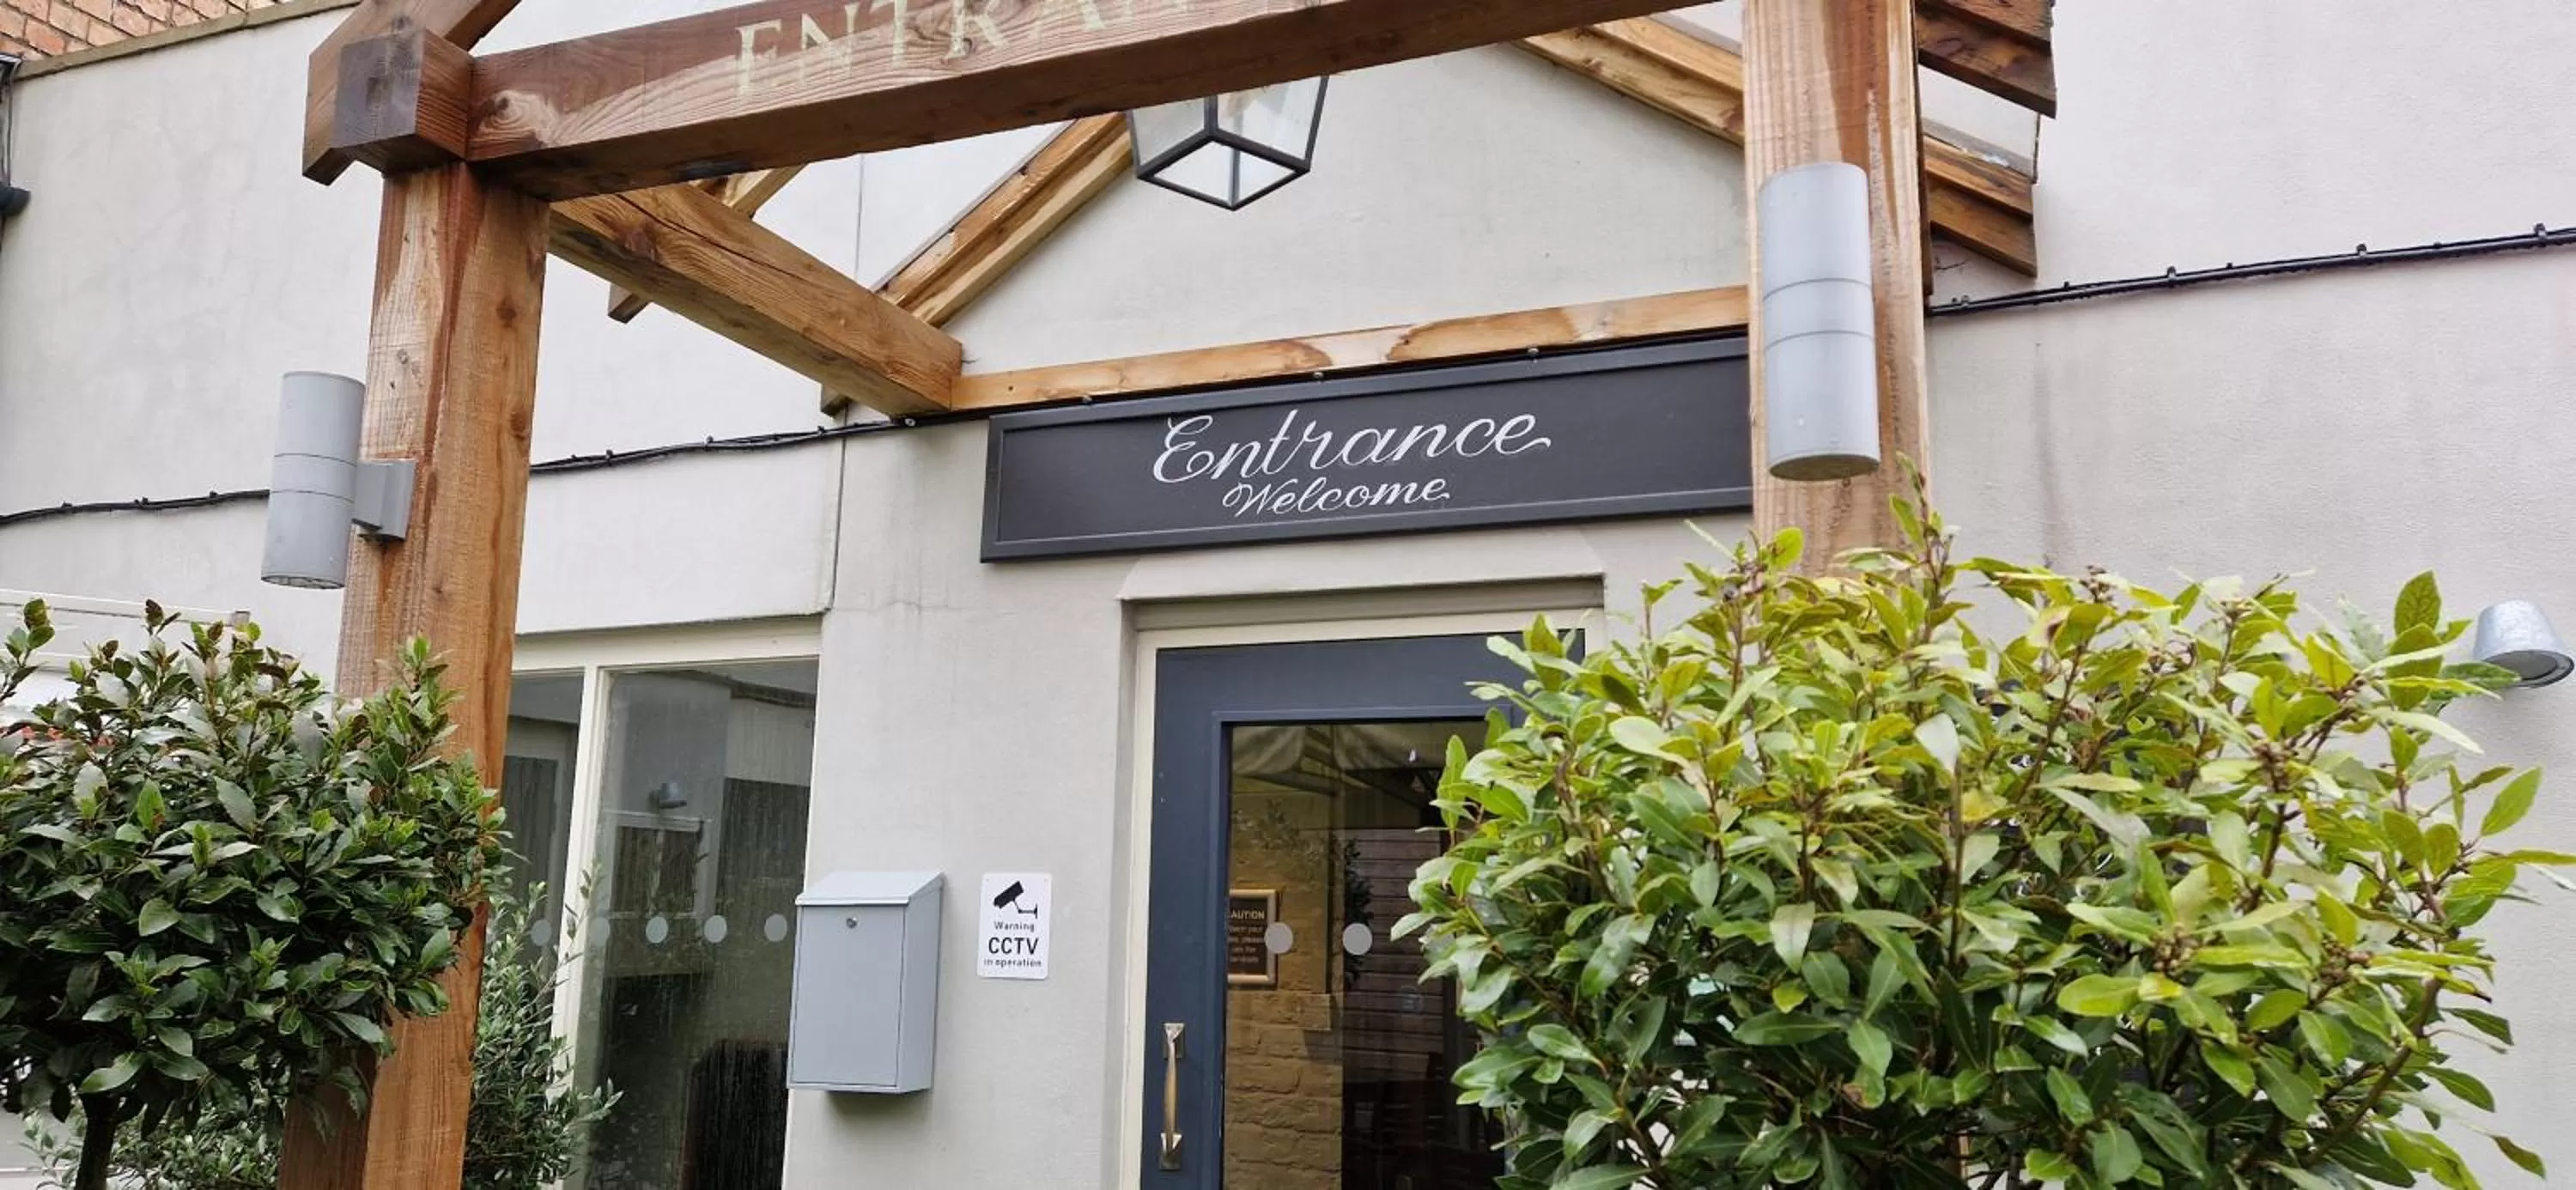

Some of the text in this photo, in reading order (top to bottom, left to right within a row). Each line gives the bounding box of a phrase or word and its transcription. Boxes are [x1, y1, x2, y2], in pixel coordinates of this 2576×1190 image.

[1152, 409, 1551, 483] Entrance
[1222, 477, 1449, 517] Welcome
[1228, 910, 1265, 920] AUTION
[993, 921, 1035, 932] Warning
[988, 937, 1039, 955] CCTV
[996, 959, 1042, 968] operation
